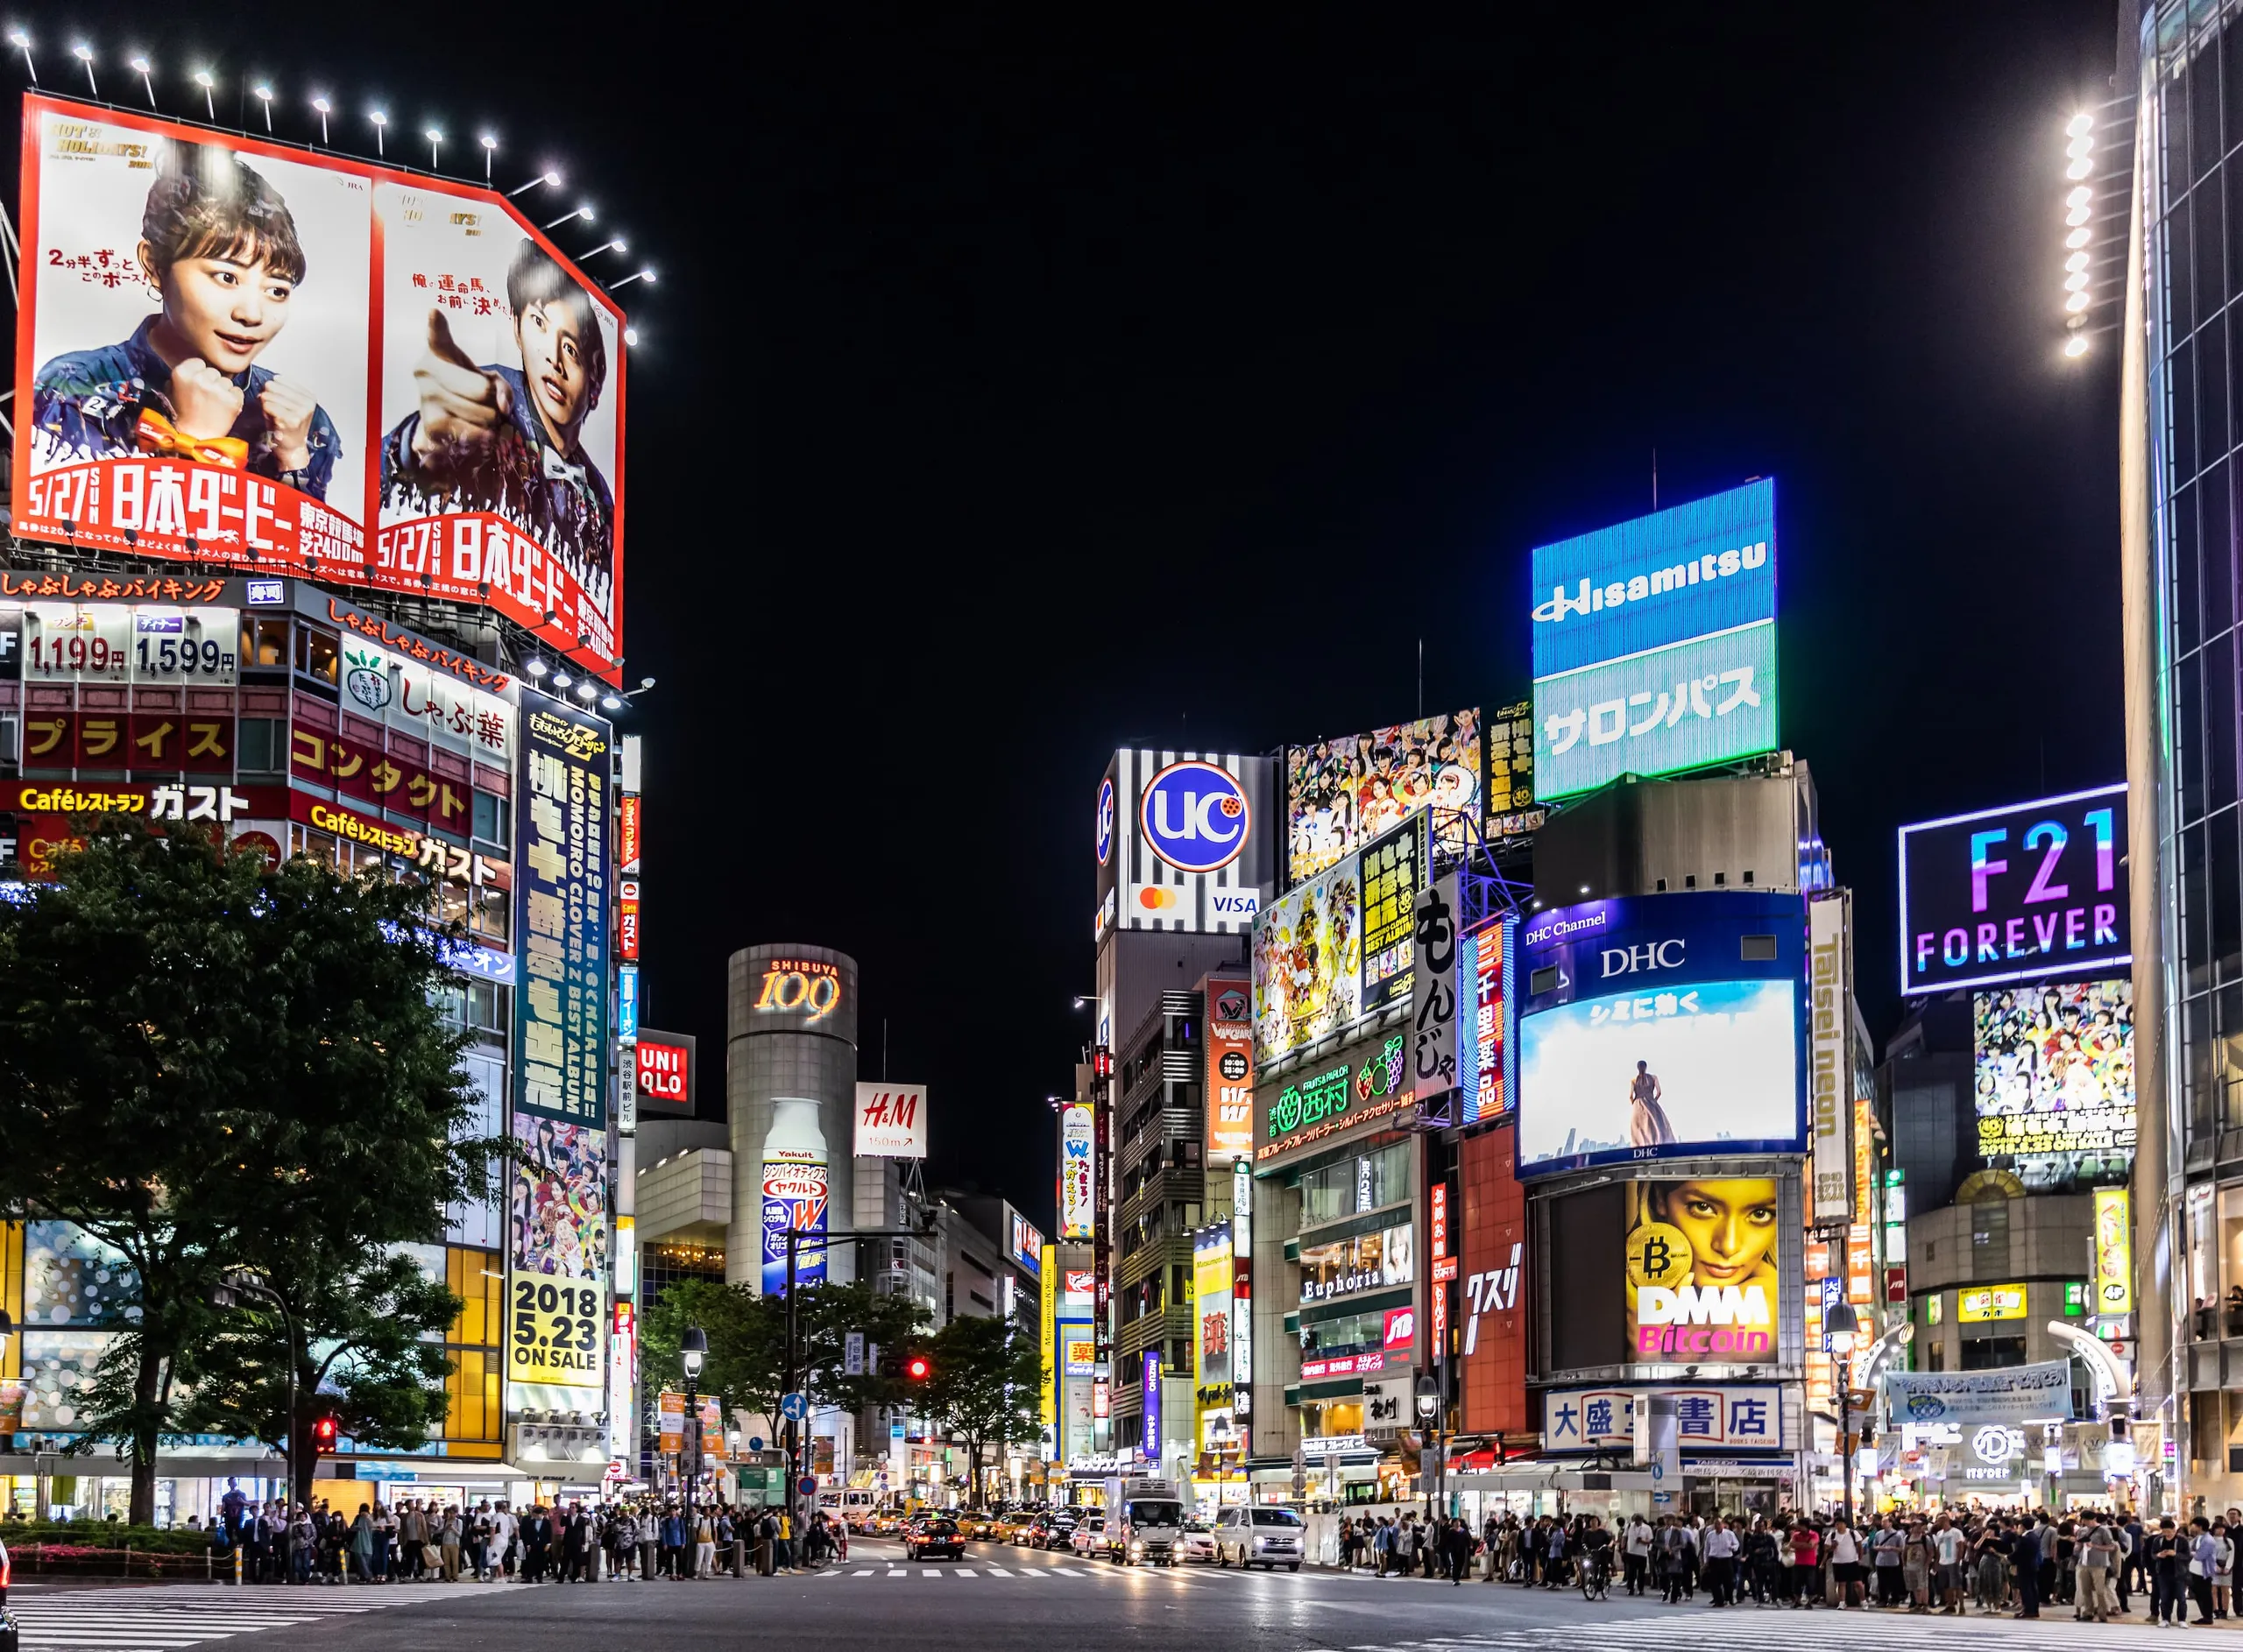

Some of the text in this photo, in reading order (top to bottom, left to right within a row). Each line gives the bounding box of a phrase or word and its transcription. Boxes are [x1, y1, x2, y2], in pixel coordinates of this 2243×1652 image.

[348, 181, 364, 191] JRA
[29, 469, 89, 522] 5/27
[89, 467, 100, 526] SUN
[113, 463, 293, 551] 日本ダービー
[377, 522, 430, 573] 5/27
[432, 521, 442, 575] SUN
[1, 573, 226, 603] しゃぶしゃぶバイキング
[1532, 541, 1766, 623] Hisamitsu
[29, 636, 125, 678] 1,199円
[137, 637, 236, 680] 1,599円
[329, 598, 511, 693] しゃぶしゃぶバイキング
[402, 676, 506, 750] しゃぶ葉
[1544, 667, 1761, 756] サロンパス
[28, 718, 227, 756] プライス
[293, 729, 465, 819] コンタクト
[150, 783, 250, 822] ガスト
[419, 838, 497, 887] ガスト
[1971, 807, 2114, 914] F21
[1213, 896, 1256, 914] VISA
[566, 766, 585, 1116] MOMOIRO CLOVER Z BEST ALBUM
[623, 914, 637, 952] ガスト
[1365, 938, 1384, 955] BEST
[1525, 912, 1606, 946] DHC Channel
[1916, 903, 2119, 972] FOREVER
[771, 960, 838, 978] SHIBUYA
[1600, 938, 1686, 978] DHC
[753, 971, 841, 1022] 109
[1416, 888, 1457, 1086] もんじゃ
[1475, 933, 1497, 1108] 三千里薬品
[1813, 932, 1840, 1138] Taisei neon
[640, 1048, 678, 1073] UNI
[622, 1059, 633, 1122] 渋谷駅前ビル
[640, 1070, 682, 1094] QLO
[1302, 1077, 1350, 1126] 西村
[863, 1092, 918, 1140] H&M
[777, 1150, 815, 1159] Yakult
[1361, 1160, 1371, 1179] BIC
[1632, 1147, 1659, 1159] DHC
[775, 1182, 818, 1195] ヤクルト
[515, 1280, 598, 1318] 2018
[1304, 1267, 1380, 1300] Euphoria
[1637, 1285, 1771, 1325] DMM
[513, 1312, 597, 1352] 5.23
[1202, 1310, 1228, 1356] 薬
[1637, 1324, 1770, 1354] Bitcoin
[514, 1346, 597, 1371] ON SALE
[1148, 1359, 1157, 1393] MIZUHO
[1553, 1396, 1768, 1438] 大盛書店
